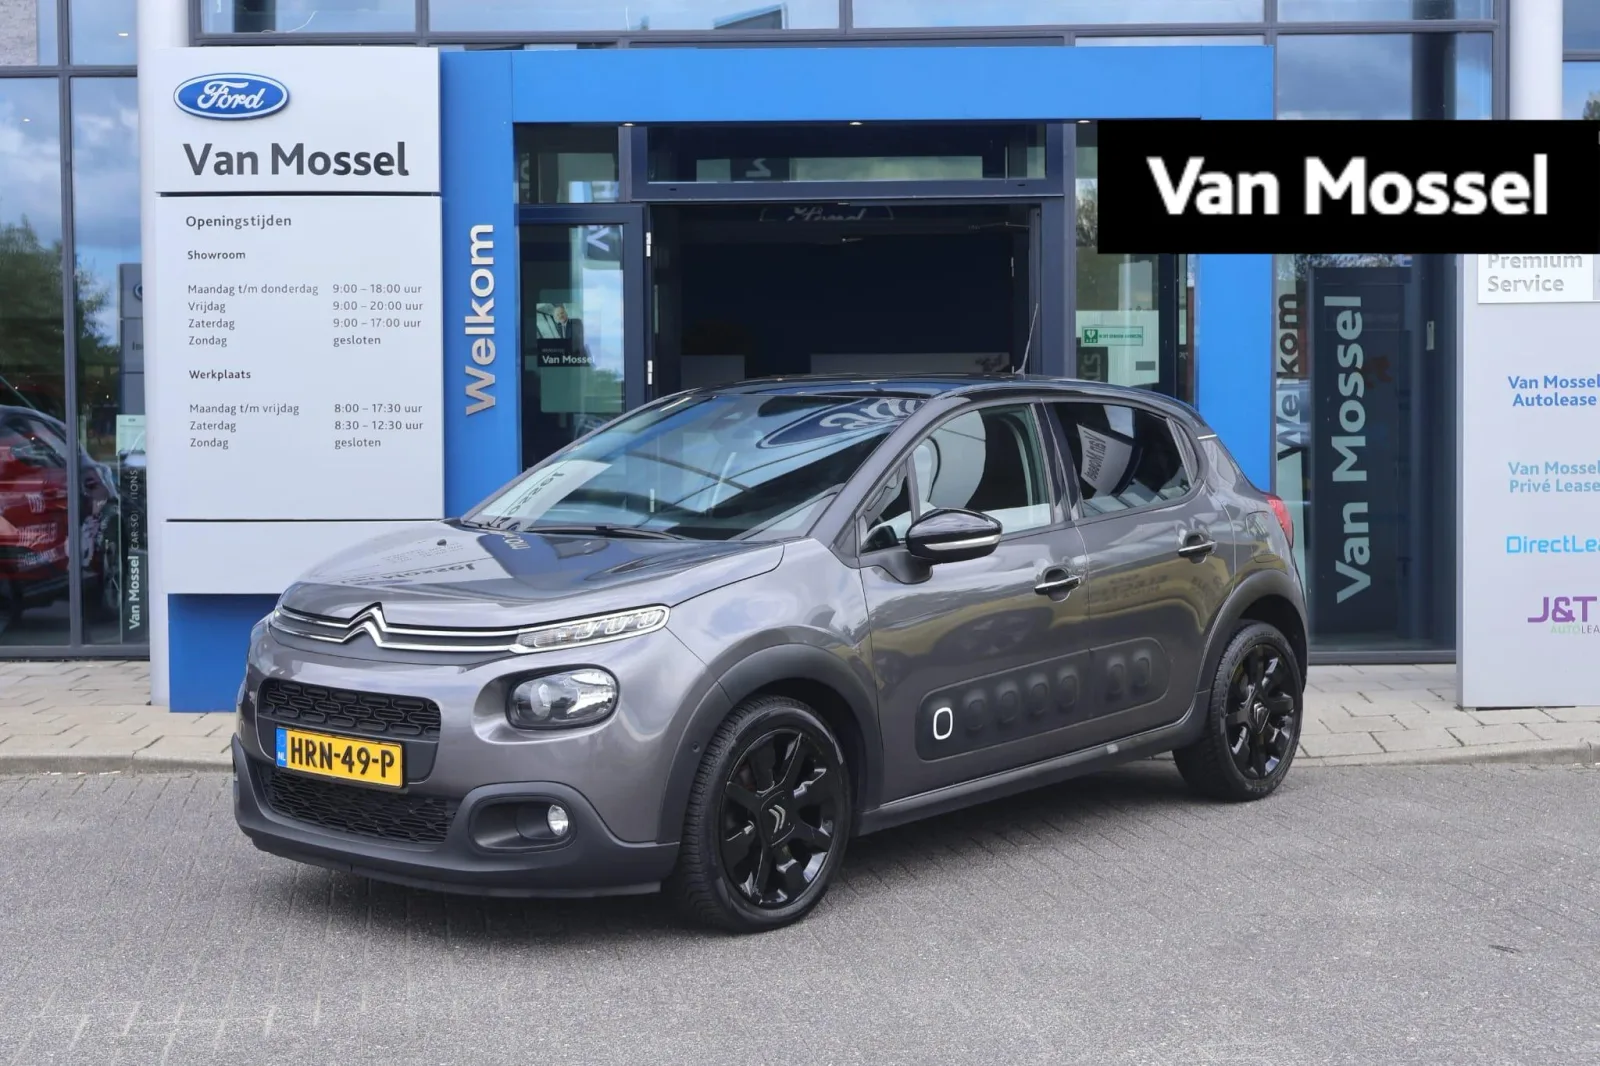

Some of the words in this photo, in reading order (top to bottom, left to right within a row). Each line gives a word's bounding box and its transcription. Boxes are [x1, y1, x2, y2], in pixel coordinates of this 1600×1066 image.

[197, 81, 266, 109] Ford
[184, 143, 258, 176] Van
[272, 141, 409, 176] Mossel
[186, 214, 292, 230] Openingstijden
[187, 250, 247, 260] Showroom
[1487, 254, 1583, 269] Premium
[188, 284, 236, 296] Maandag
[238, 284, 258, 294] t/m
[261, 284, 319, 296] donderdag
[333, 284, 358, 294] 9:00
[371, 284, 401, 294] 18:00
[404, 285, 423, 294] uur
[1487, 274, 1565, 292] Service
[188, 301, 226, 314] Vrijdag
[333, 301, 358, 311] 9:00
[370, 301, 402, 311] 20:00
[405, 302, 424, 311] uur
[188, 318, 236, 331] Zaterdag
[333, 318, 358, 328] 9:00
[371, 318, 400, 328] 17:00
[403, 319, 422, 328] uur
[465, 224, 496, 416] Welkom
[188, 335, 228, 348] Zondag
[333, 334, 381, 347] gesloten
[189, 369, 252, 381] Werkplaats
[1507, 376, 1539, 389] Van
[1543, 374, 1600, 389] Mossel
[1323, 295, 1368, 482] Mossel
[1512, 392, 1597, 407] Autolease
[189, 403, 237, 416] Maandag
[239, 403, 260, 413] t/m
[262, 403, 300, 416] vrijdag
[334, 403, 359, 413] 8:00
[372, 403, 402, 413] 17:30
[404, 404, 423, 413] uur
[190, 420, 237, 433] Zaterdag
[334, 420, 360, 430] 8:30
[372, 420, 402, 430] 12:30
[405, 421, 424, 430] uur
[190, 437, 229, 450] Zondag
[334, 436, 381, 450] gesloten
[1507, 462, 1540, 475] Van
[1544, 460, 1600, 475] Mossel
[1509, 479, 1551, 493] Privé
[1555, 478, 1600, 493] Lease
[1506, 535, 1600, 554] DirectLe
[1335, 501, 1372, 604] Van
[127, 555, 140, 602] Mossel
[1527, 595, 1598, 623] J&T
[129, 604, 141, 631] Van
[291, 736, 395, 779] HRN-49-P
